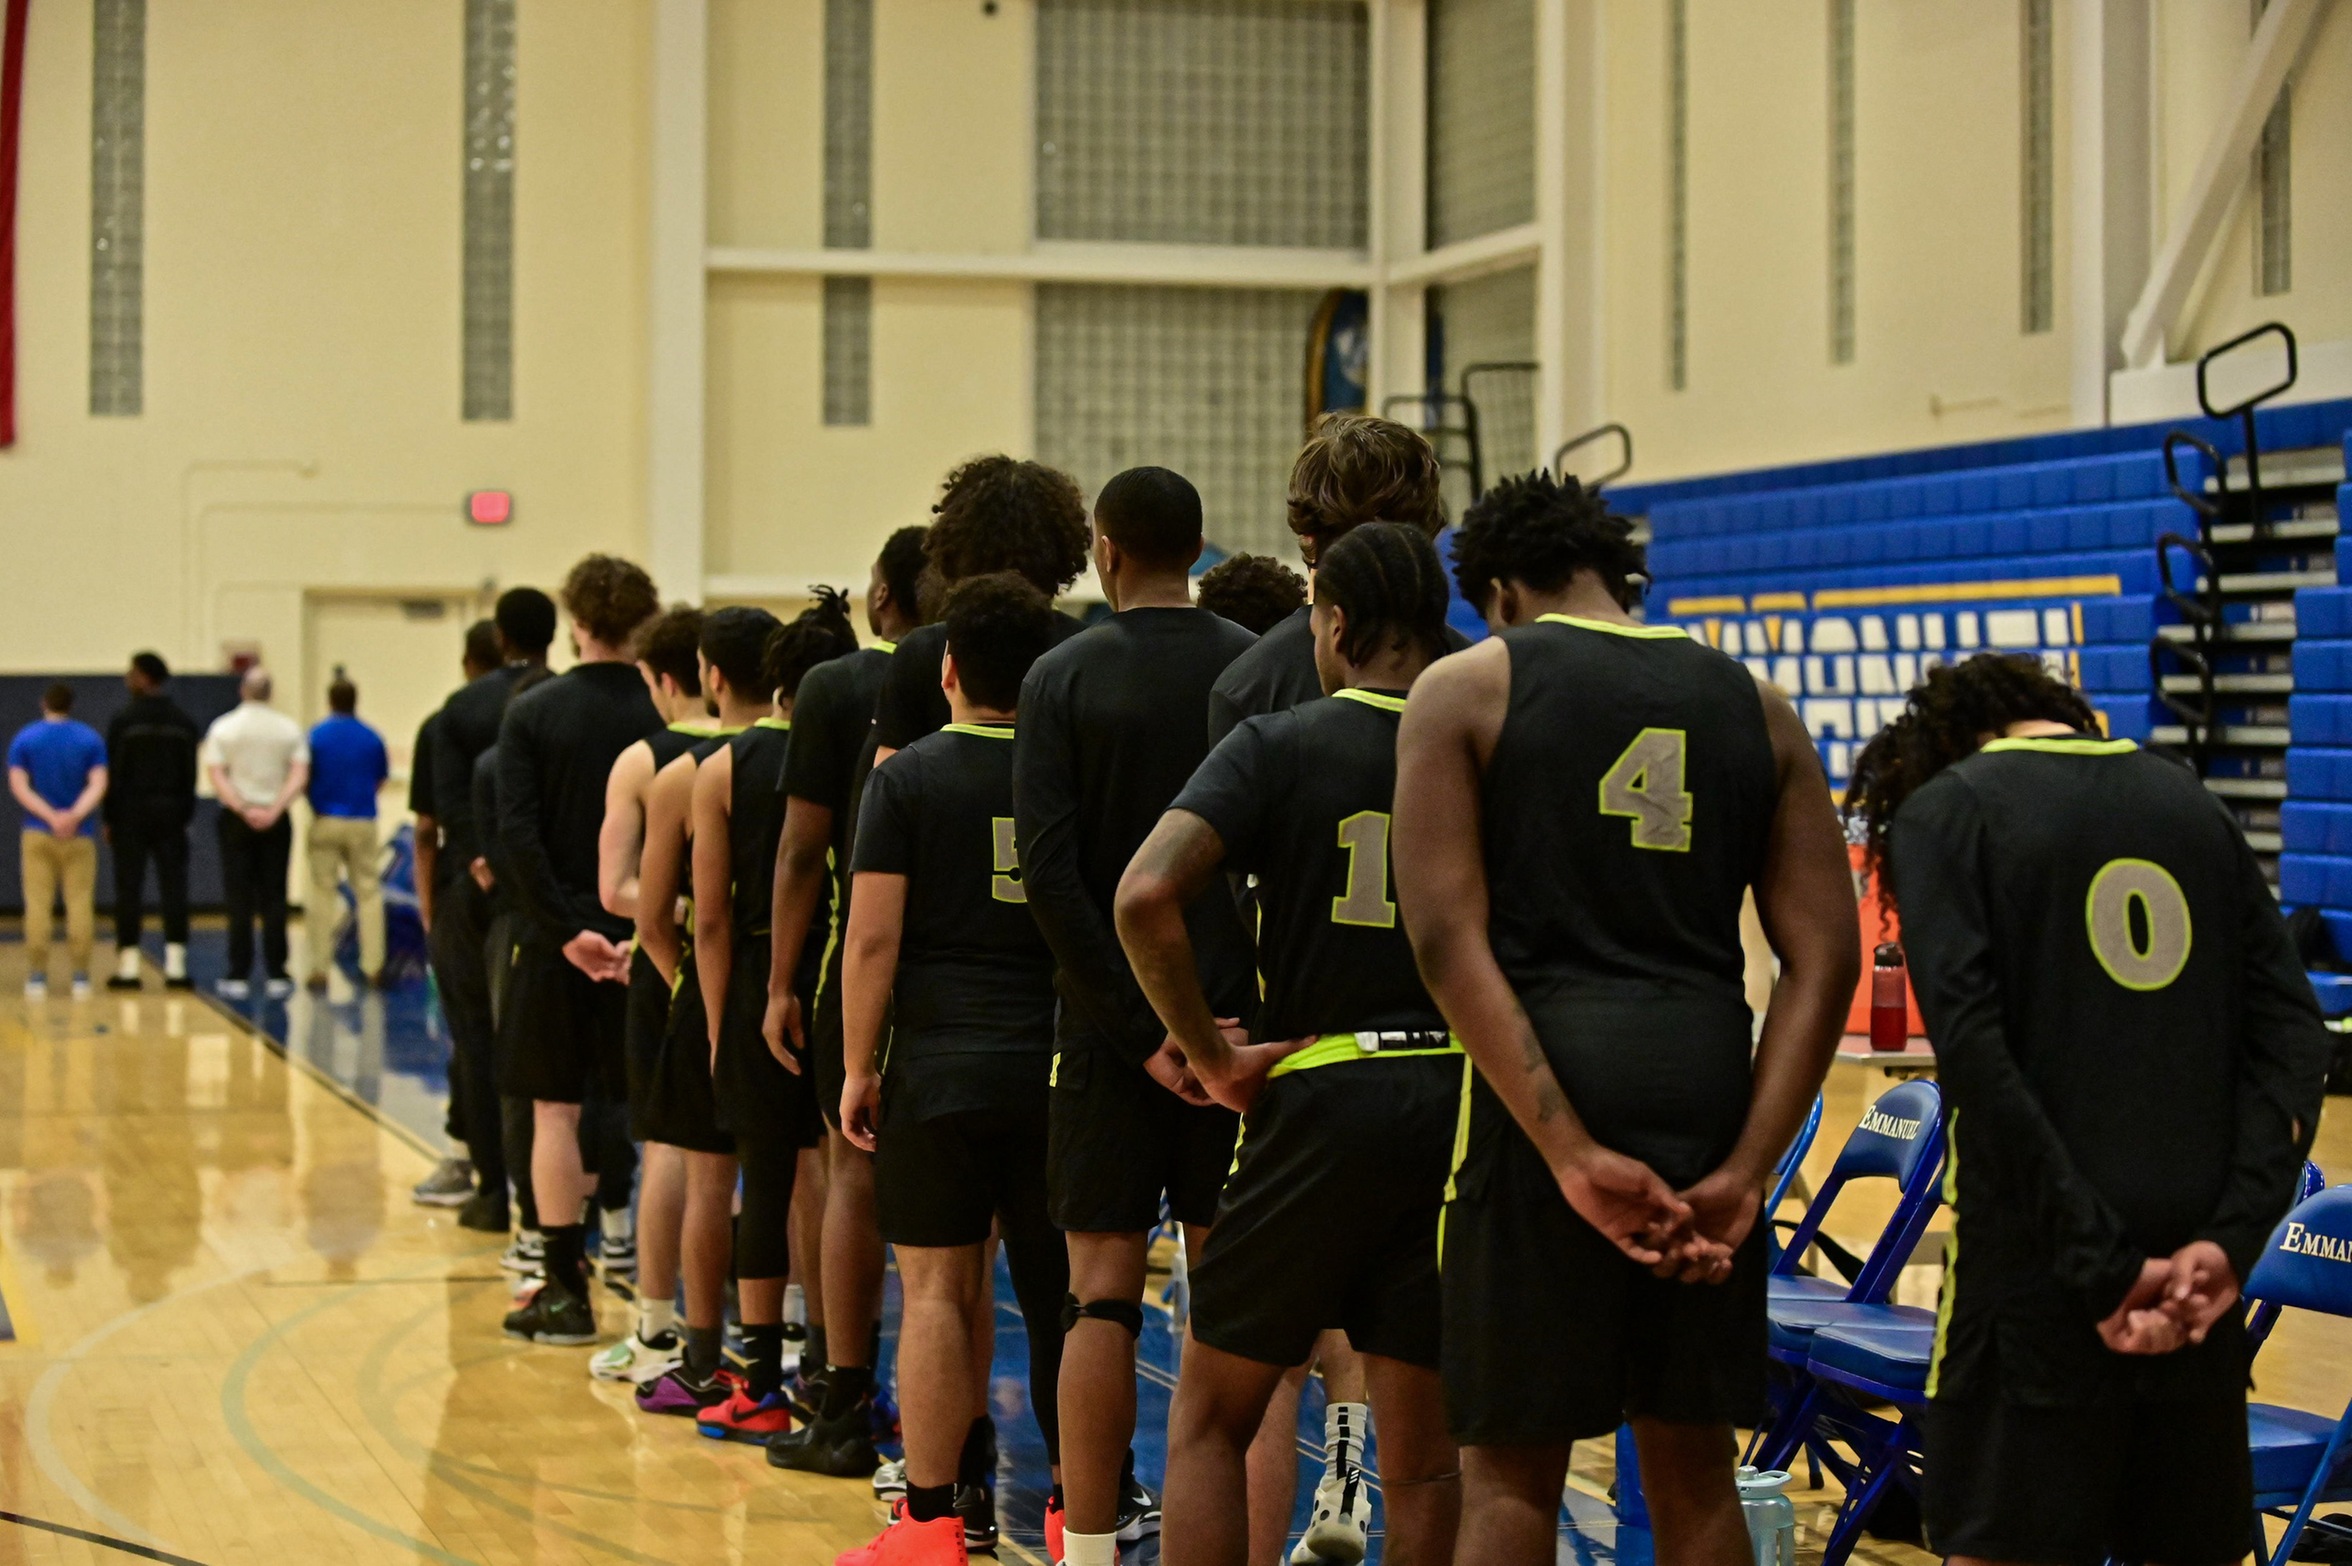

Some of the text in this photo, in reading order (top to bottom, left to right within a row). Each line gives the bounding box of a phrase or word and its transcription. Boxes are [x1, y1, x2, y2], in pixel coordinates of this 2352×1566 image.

[1599, 727, 1693, 852] 4
[1331, 810, 1395, 928] 1
[2085, 857, 2193, 991] 0
[1858, 1105, 1920, 1140] EMMANUEL
